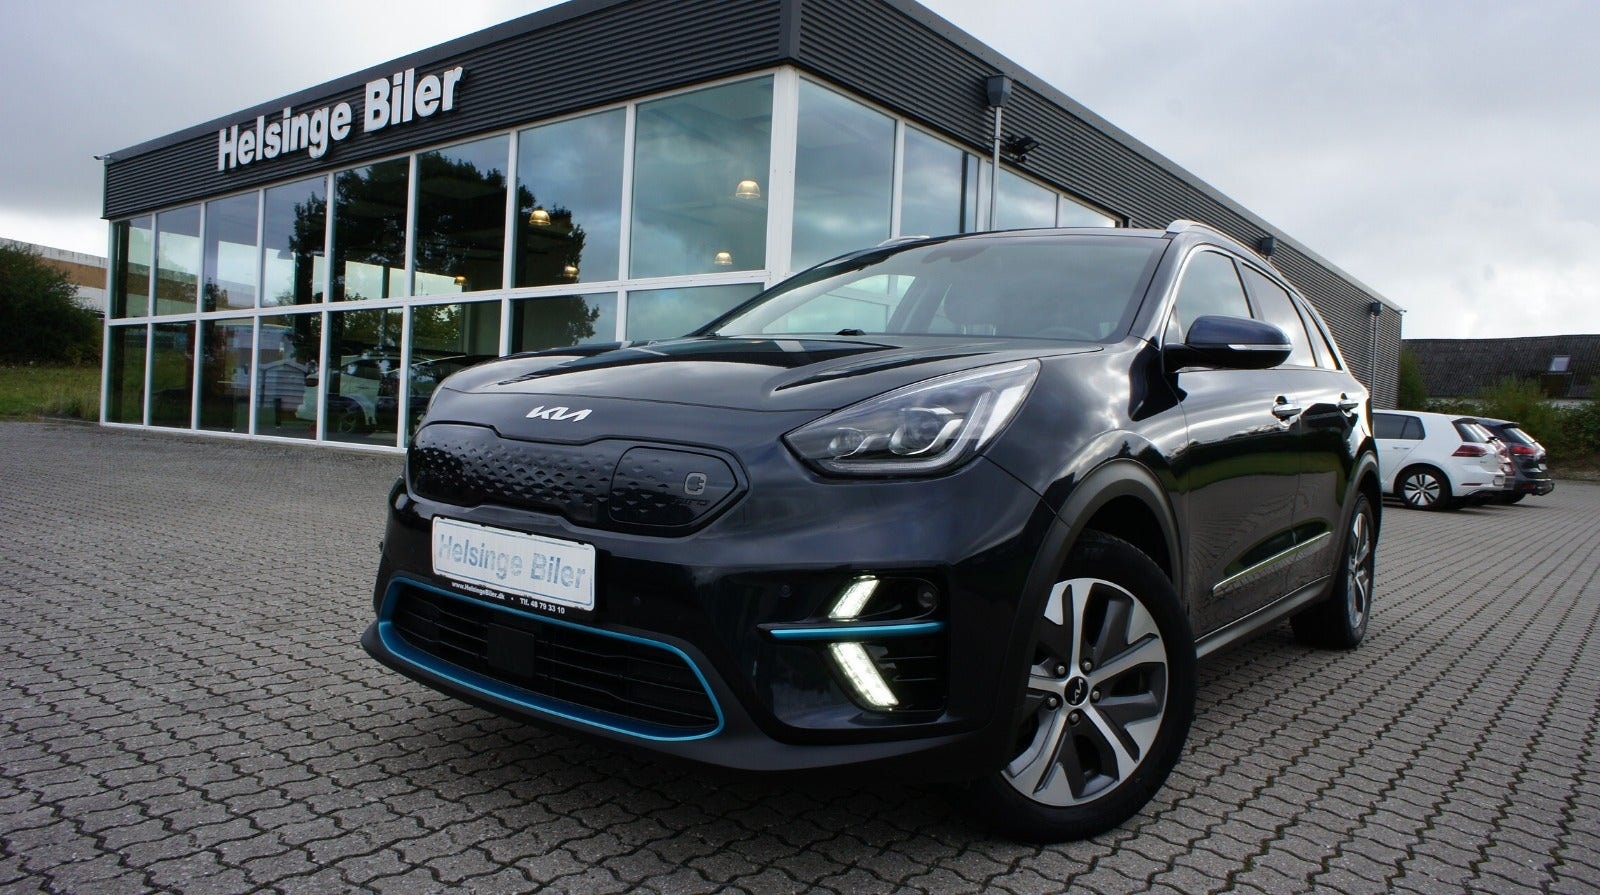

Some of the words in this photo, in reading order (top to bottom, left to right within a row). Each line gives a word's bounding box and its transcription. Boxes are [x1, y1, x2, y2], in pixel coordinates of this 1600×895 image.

[218, 102, 352, 171] Helsinge
[364, 66, 463, 132] Biler
[526, 405, 593, 422] KIA
[438, 533, 523, 580] Helsinge
[530, 552, 586, 589] Biler
[557, 607, 566, 615] 10
